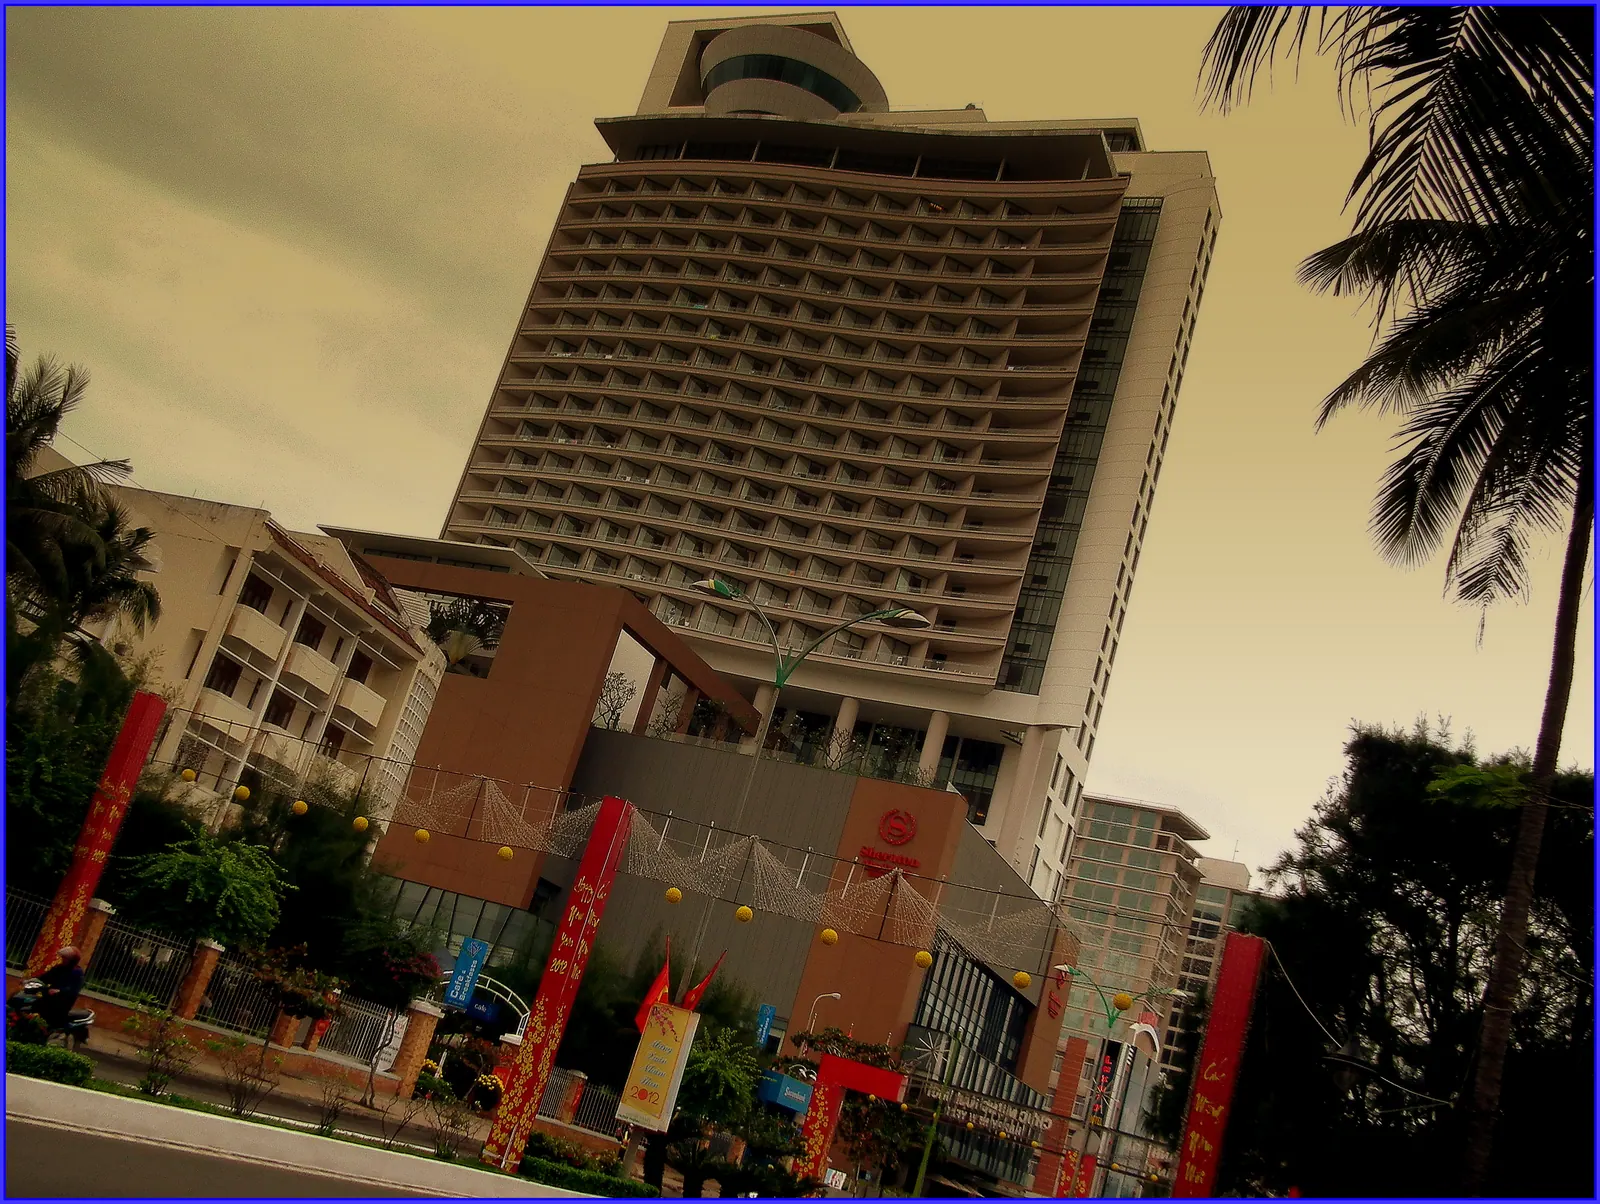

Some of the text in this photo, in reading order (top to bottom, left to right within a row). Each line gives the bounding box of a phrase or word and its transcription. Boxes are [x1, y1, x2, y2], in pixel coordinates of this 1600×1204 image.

[550, 958, 567, 975] 2012
[450, 976, 465, 998] Cafe
[630, 1085, 660, 1105] 2012
